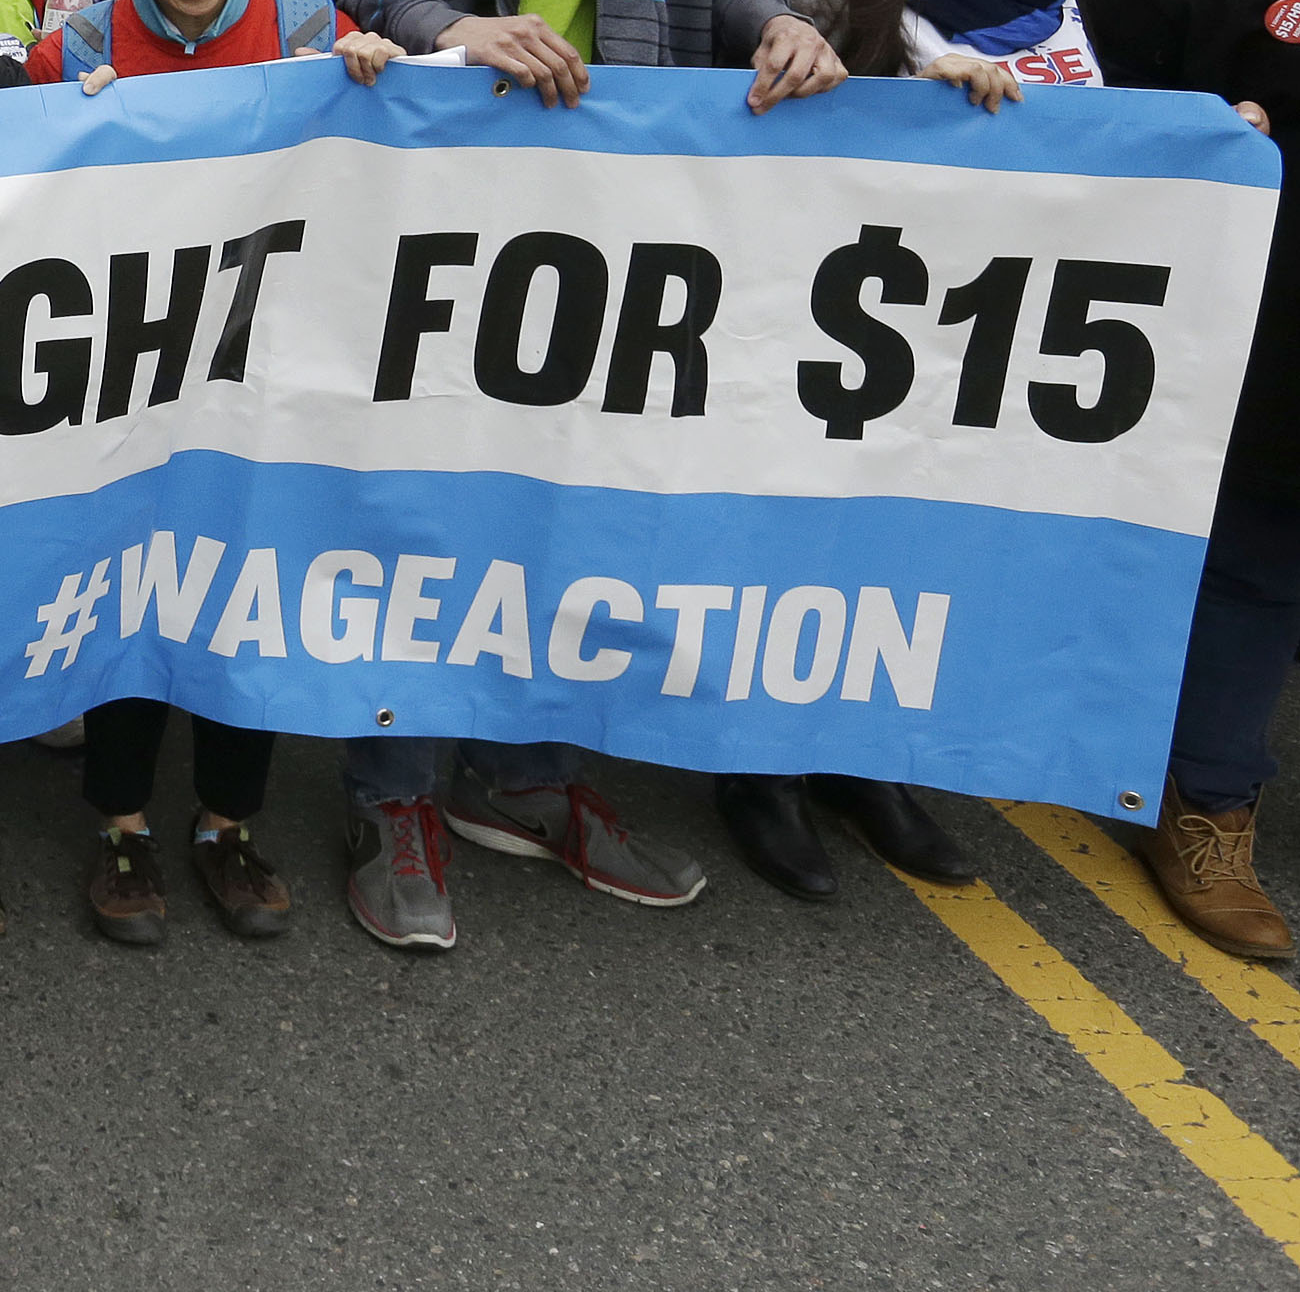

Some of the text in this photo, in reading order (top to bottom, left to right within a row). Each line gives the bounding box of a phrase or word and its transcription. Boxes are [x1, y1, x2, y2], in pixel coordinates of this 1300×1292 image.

[373, 229, 724, 420] FOR
[797, 224, 1173, 442] $15
[22, 529, 951, 711] #WAGEACTION
